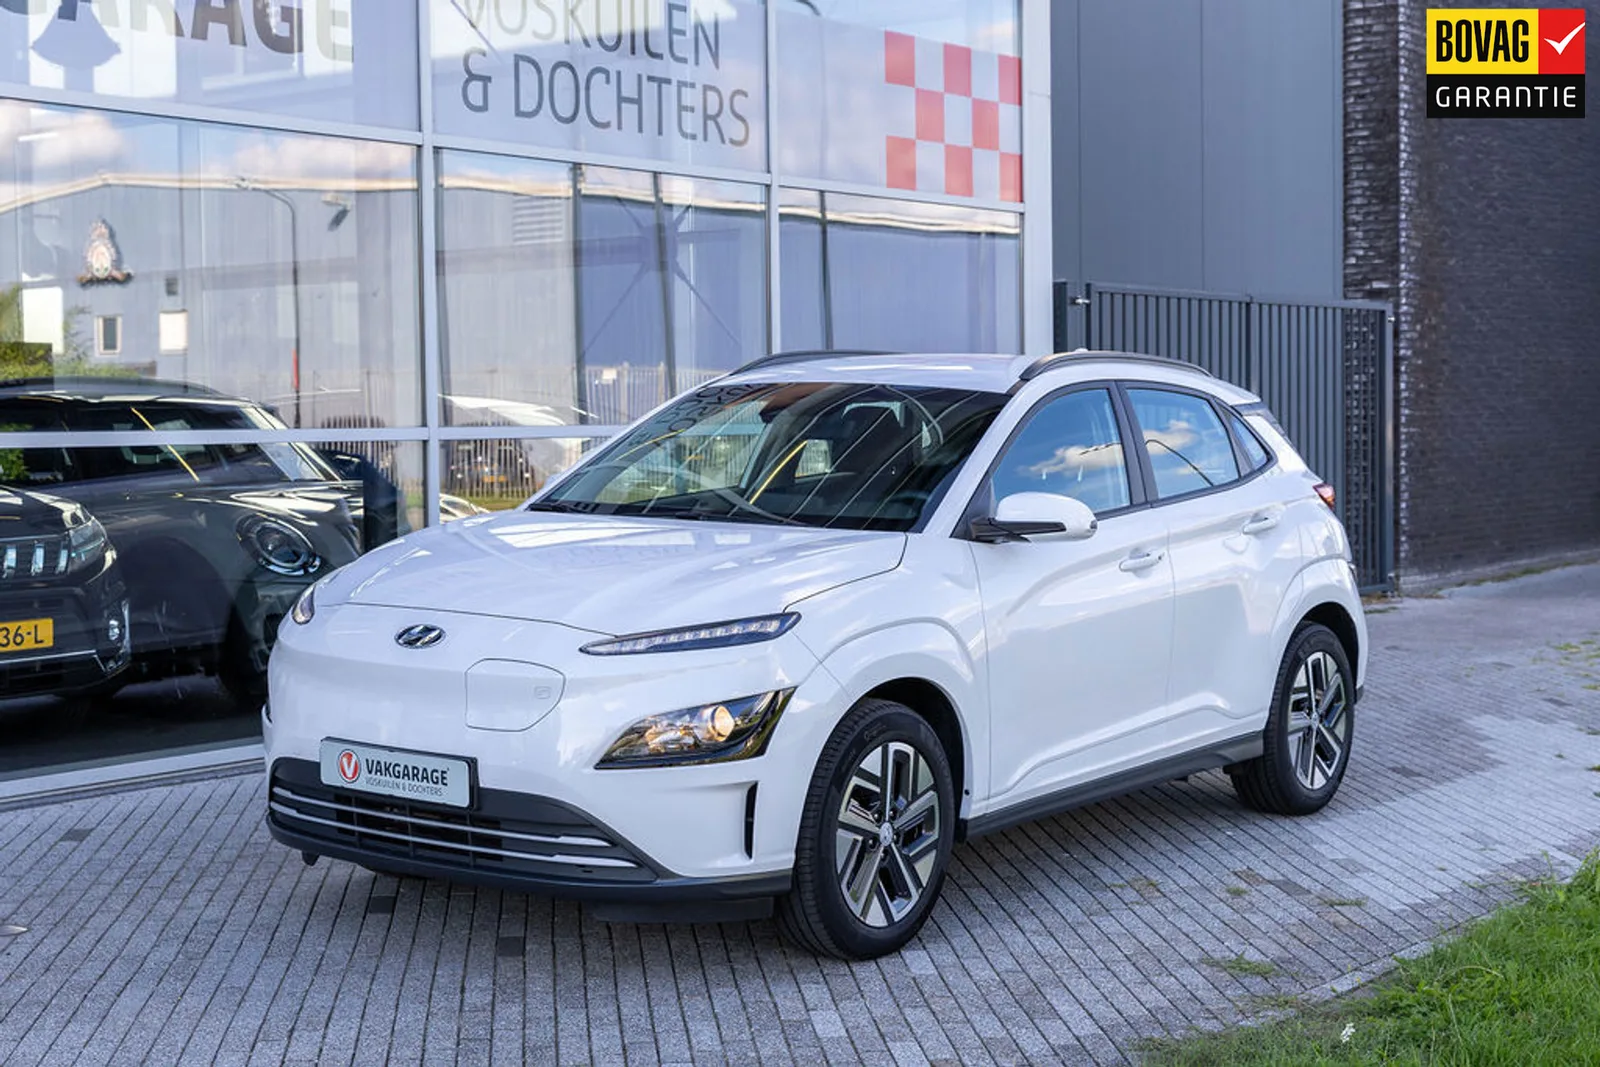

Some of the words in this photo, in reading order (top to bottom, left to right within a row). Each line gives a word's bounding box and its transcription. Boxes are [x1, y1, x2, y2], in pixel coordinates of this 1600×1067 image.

[461, 47, 492, 113] &
[513, 53, 750, 147] DOCHTERS
[365, 758, 448, 786] VAKGARAGE
[407, 782, 443, 797] DOCHTERS
